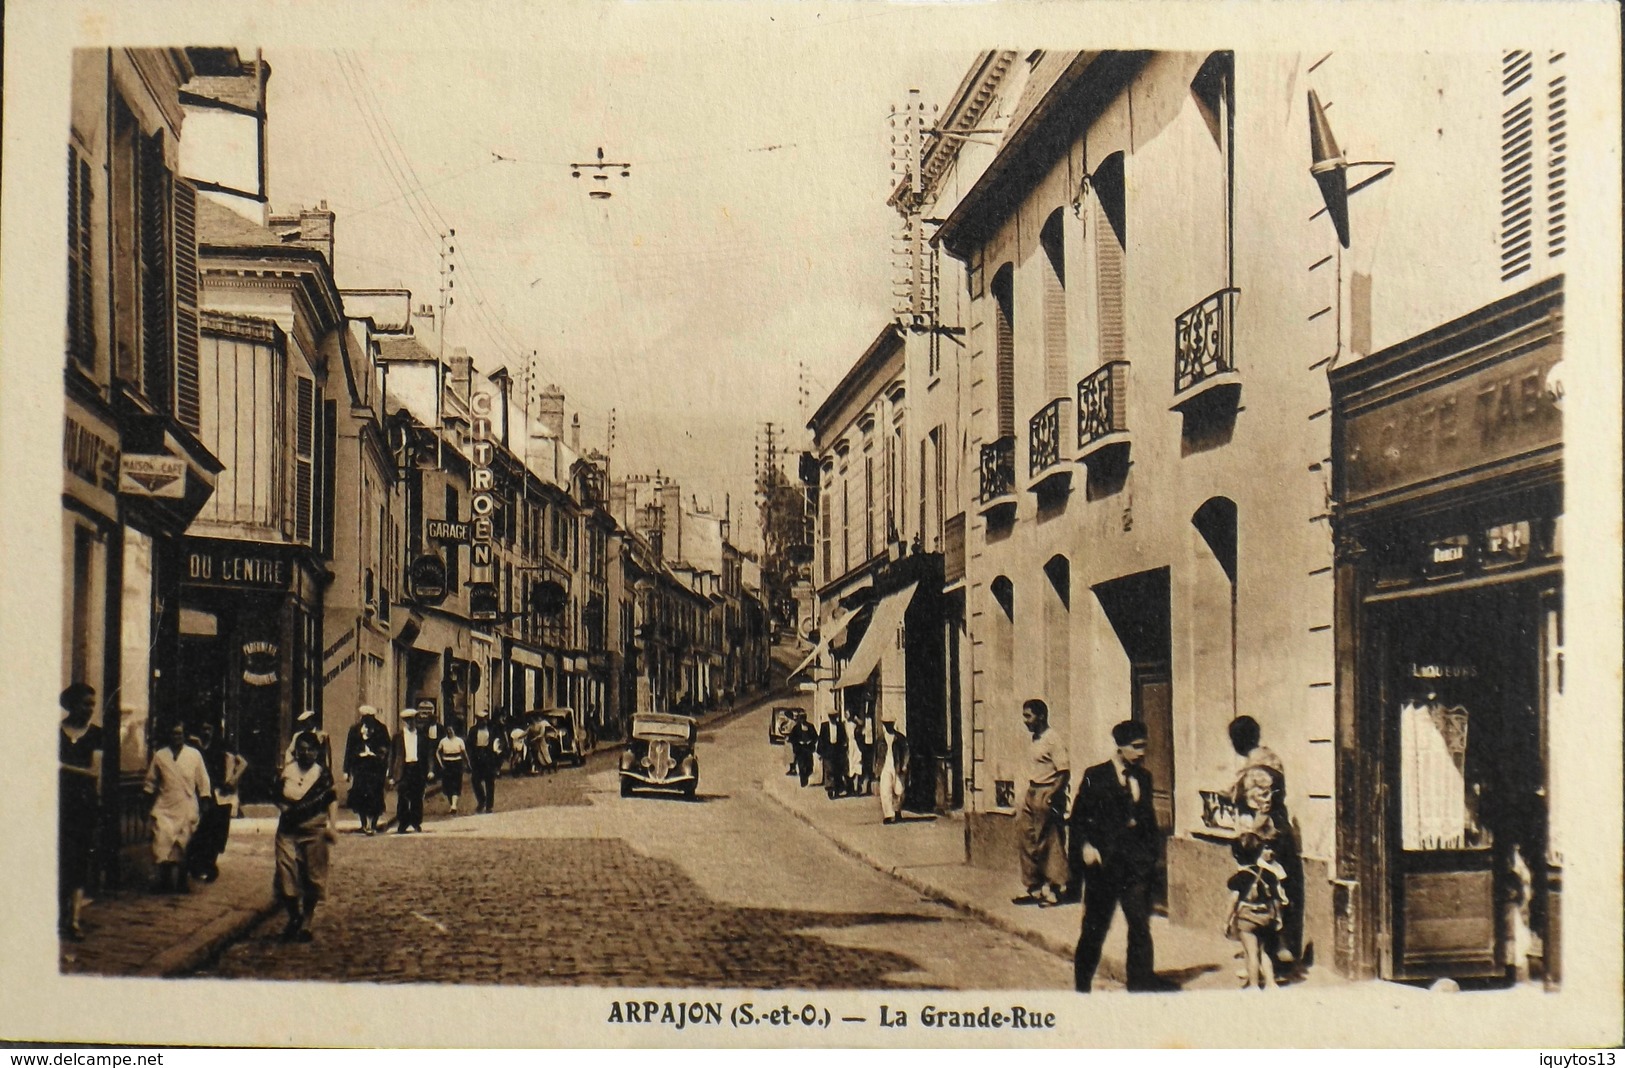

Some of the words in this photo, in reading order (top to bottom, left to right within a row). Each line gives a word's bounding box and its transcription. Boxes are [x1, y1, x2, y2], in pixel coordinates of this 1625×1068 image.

[429, 522, 468, 540] GARAGE
[190, 554, 212, 579] DU
[222, 557, 284, 584] CENTRE
